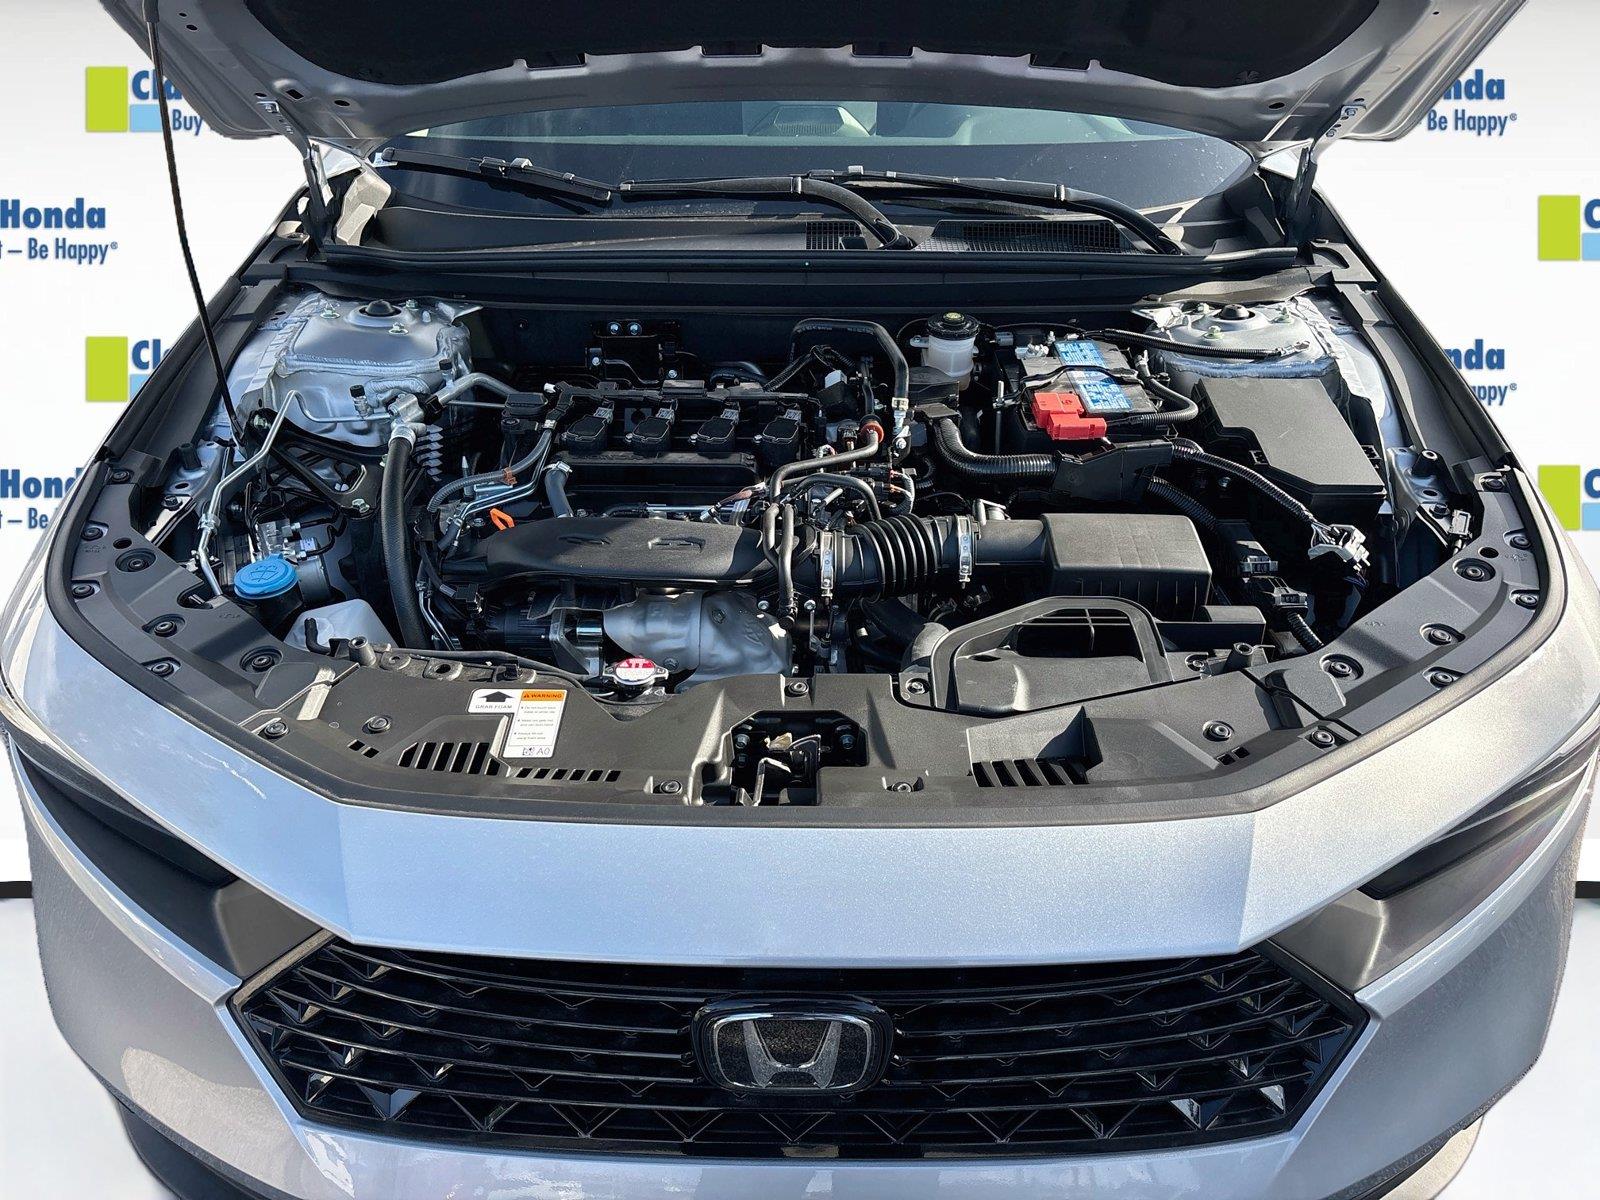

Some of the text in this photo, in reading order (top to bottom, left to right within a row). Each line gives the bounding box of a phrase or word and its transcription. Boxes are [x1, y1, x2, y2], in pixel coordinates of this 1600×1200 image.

[172, 109, 203, 136] Buy
[1427, 109, 1448, 131] Be
[0, 197, 105, 229] Honda
[28, 237, 49, 260] Be
[28, 507, 49, 530] Be
